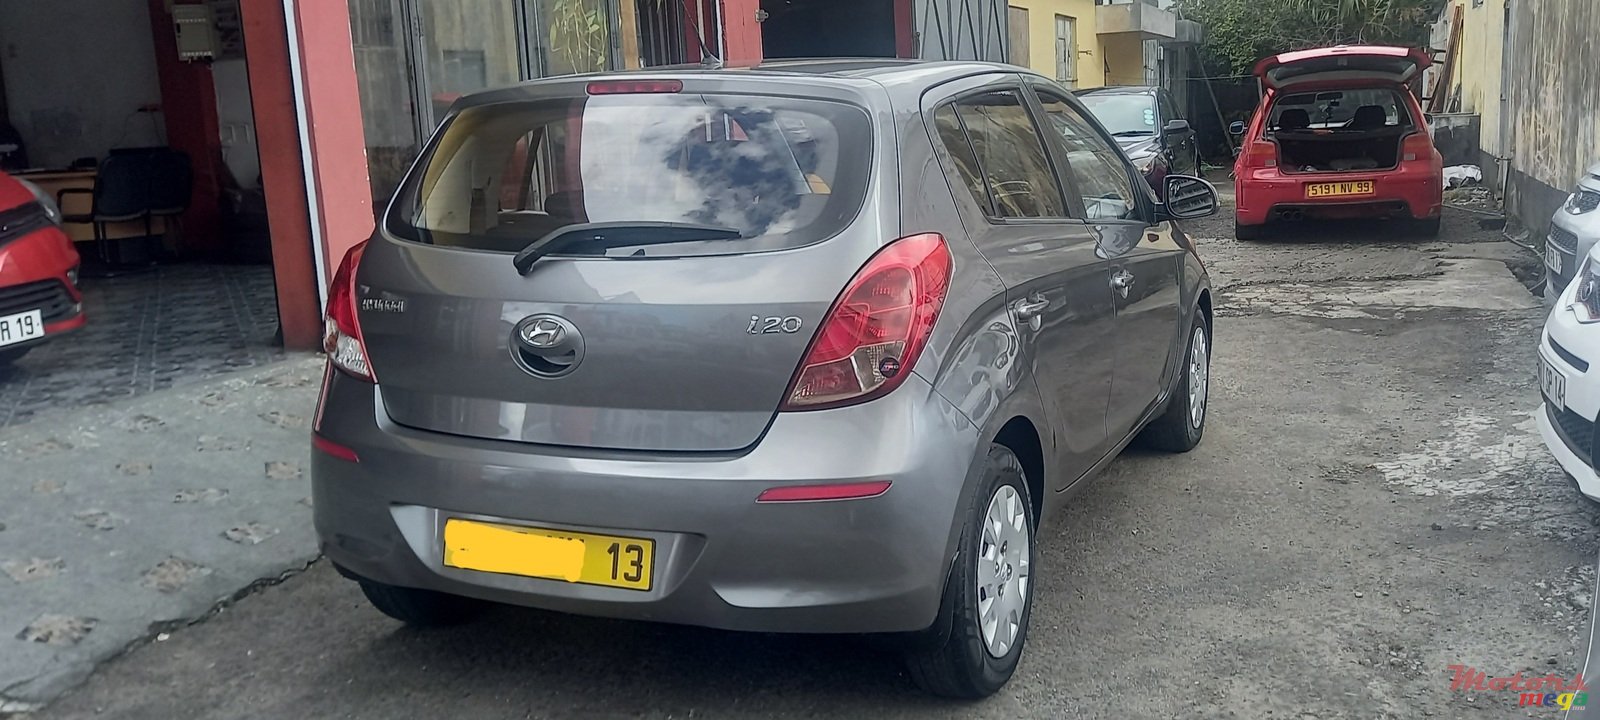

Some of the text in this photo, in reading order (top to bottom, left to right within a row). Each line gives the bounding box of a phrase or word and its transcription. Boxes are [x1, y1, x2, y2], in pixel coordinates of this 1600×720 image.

[1311, 182, 1370, 195] 5191 NV 99
[16, 315, 34, 337] 19
[746, 315, 803, 335] i20
[608, 542, 643, 582] 13
